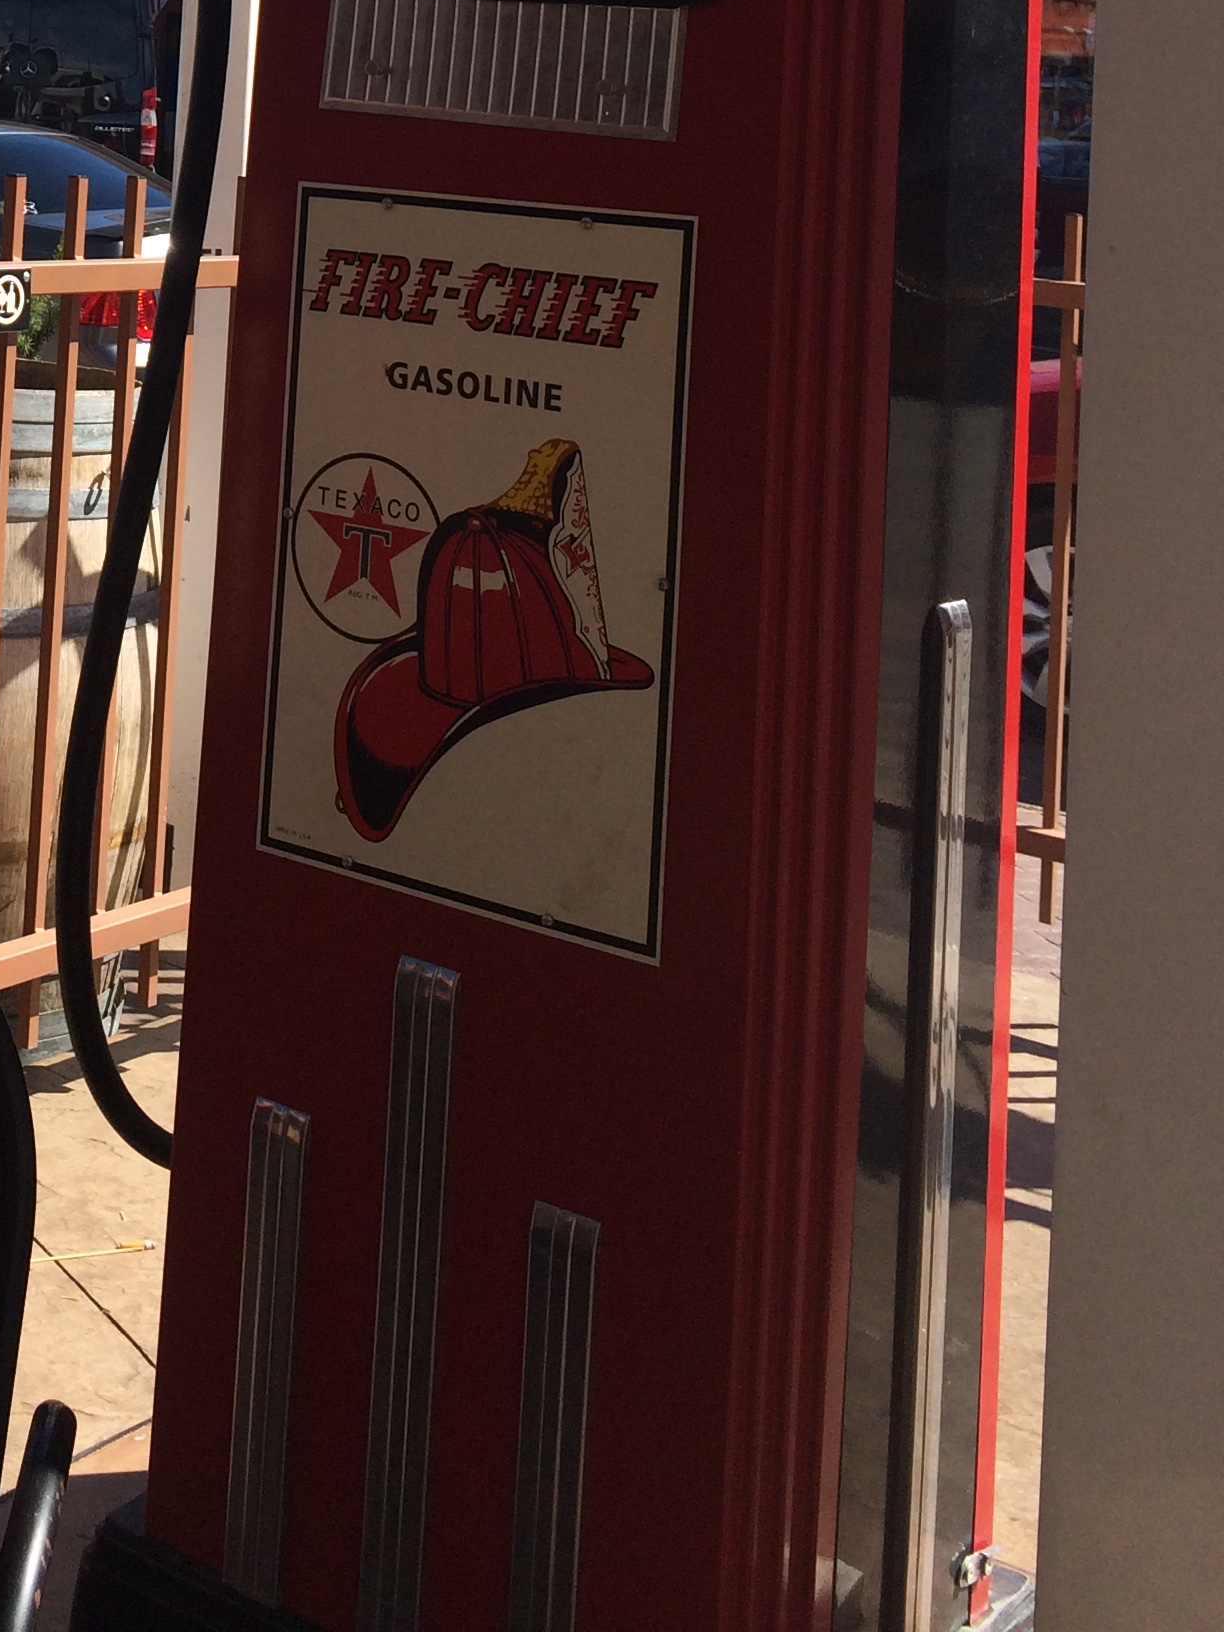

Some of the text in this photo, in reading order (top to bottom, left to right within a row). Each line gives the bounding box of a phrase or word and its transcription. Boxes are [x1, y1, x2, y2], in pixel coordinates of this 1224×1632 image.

[307, 248, 658, 348] FIRE-CHIEF
[387, 361, 562, 411] GASOLINE
[318, 485, 421, 523] TEXACO
